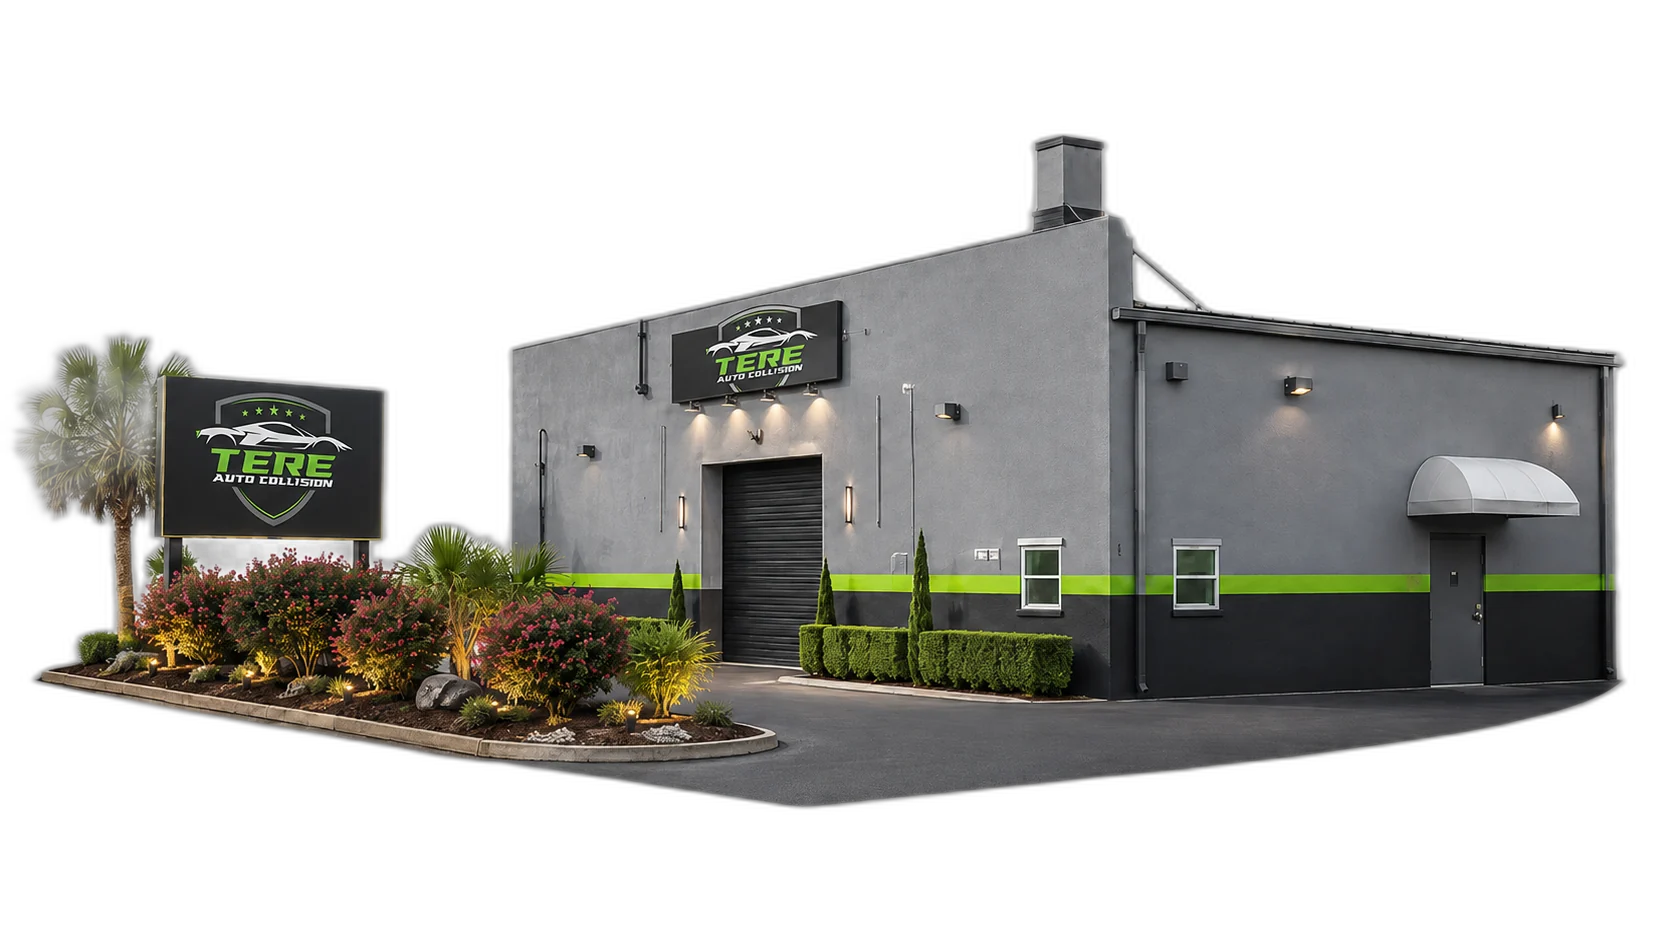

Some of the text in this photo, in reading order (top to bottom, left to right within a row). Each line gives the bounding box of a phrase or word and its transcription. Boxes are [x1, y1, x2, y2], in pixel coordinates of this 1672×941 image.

[715, 344, 805, 376] TERE
[716, 363, 803, 383] AUTO COLLISION
[211, 447, 336, 478] TERE
[212, 473, 333, 488] AUTO COLLISION
